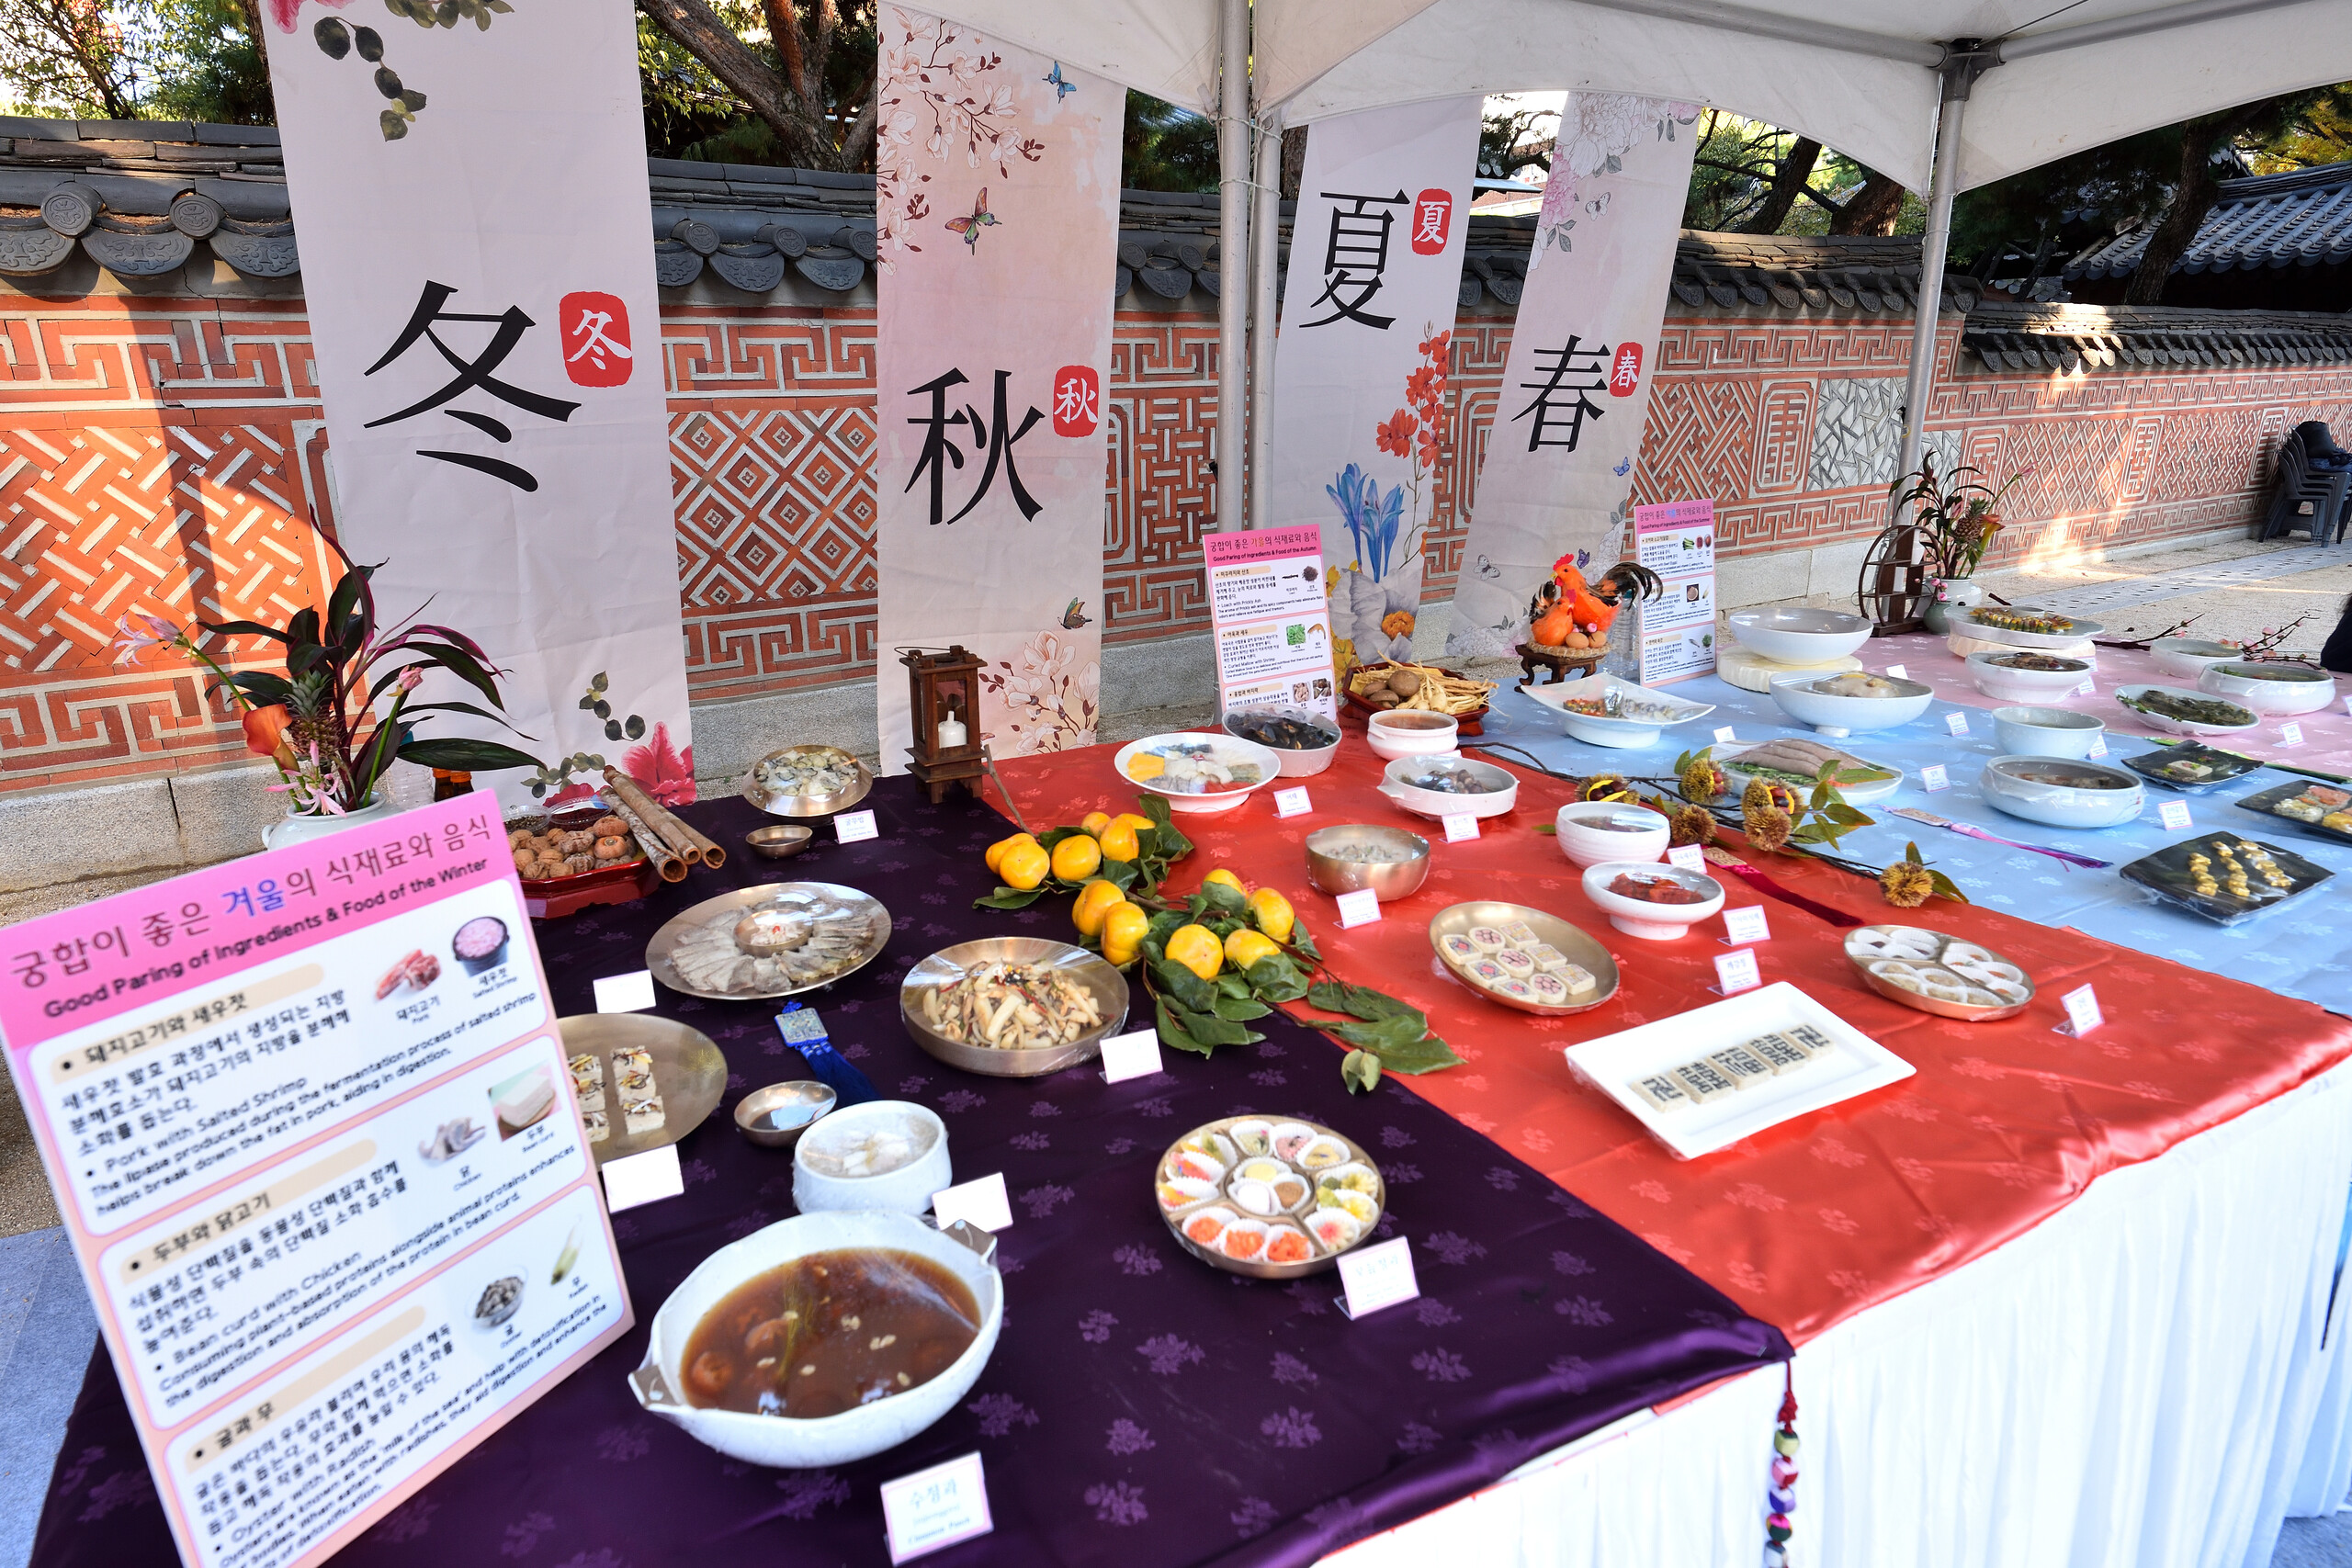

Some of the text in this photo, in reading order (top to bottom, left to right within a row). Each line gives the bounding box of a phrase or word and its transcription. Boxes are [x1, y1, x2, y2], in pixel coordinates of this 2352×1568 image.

[1299, 188, 1410, 330] 夏
[1414, 200, 1451, 244] 夏
[363, 279, 582, 492] 冬
[566, 309, 632, 369] 冬
[1511, 334, 1611, 453] 春
[1611, 350, 1639, 387] 春
[904, 367, 1046, 525] 秋
[1054, 378, 1098, 424] 秋
[1210, 531, 1317, 552] 궁합이 좋은 가을의 식재료와 음식
[1247, 550, 1271, 558] Ingredients
[13, 814, 491, 987] 궁합이 좋은 겨울의 식재료와 음식
[44, 858, 486, 1017] Good Paring of Ingredients & Food of the Winter
[83, 991, 248, 1064] 돼지고기와 새우젓
[90, 992, 536, 1198] The lipase produced during the fermentation process of salted shrimp
[95, 1047, 451, 1216] helps break down the fat in pork, aiding in digestion.
[104, 1077, 307, 1172] Pork with Salted Shrimp
[152, 1190, 271, 1262] 두부와 닭고기
[159, 1145, 574, 1392] Consuming plant-based proteins alongside animal proteins enhances
[164, 1190, 520, 1407] the digestion and absorption of the protein in bean curd.
[172, 1251, 362, 1364] Bean curd with Chicken
